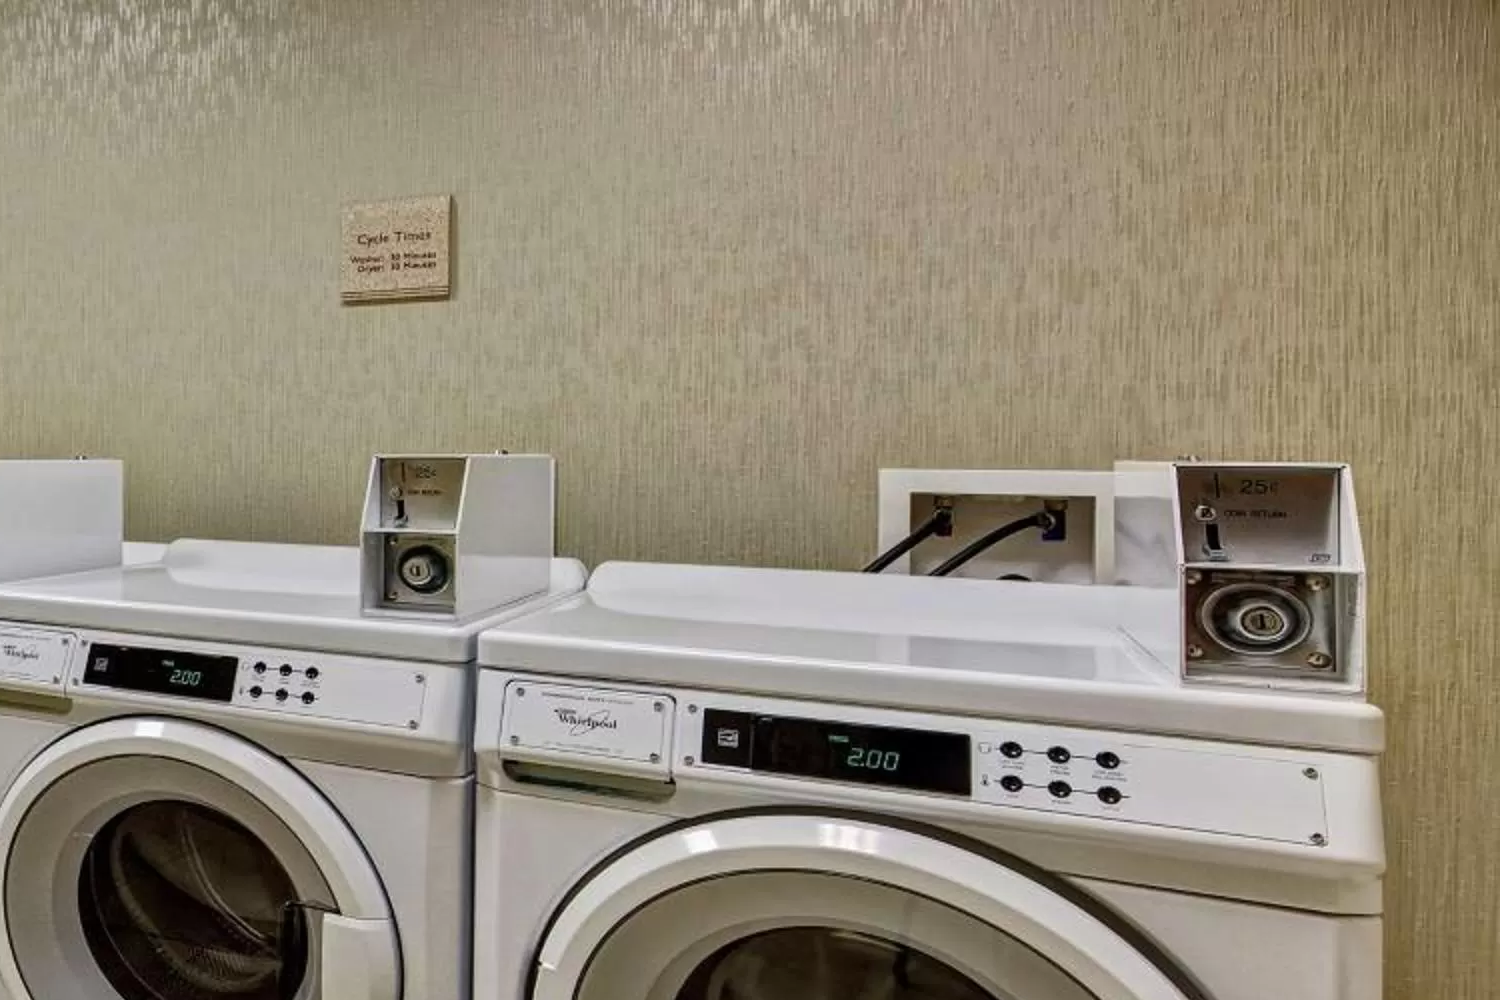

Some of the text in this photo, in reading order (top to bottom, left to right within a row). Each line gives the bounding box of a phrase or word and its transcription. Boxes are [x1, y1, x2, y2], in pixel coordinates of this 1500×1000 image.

[357, 233, 389, 248] Cycle
[558, 712, 617, 730] Whirlpool
[847, 747, 900, 771] 2.00
